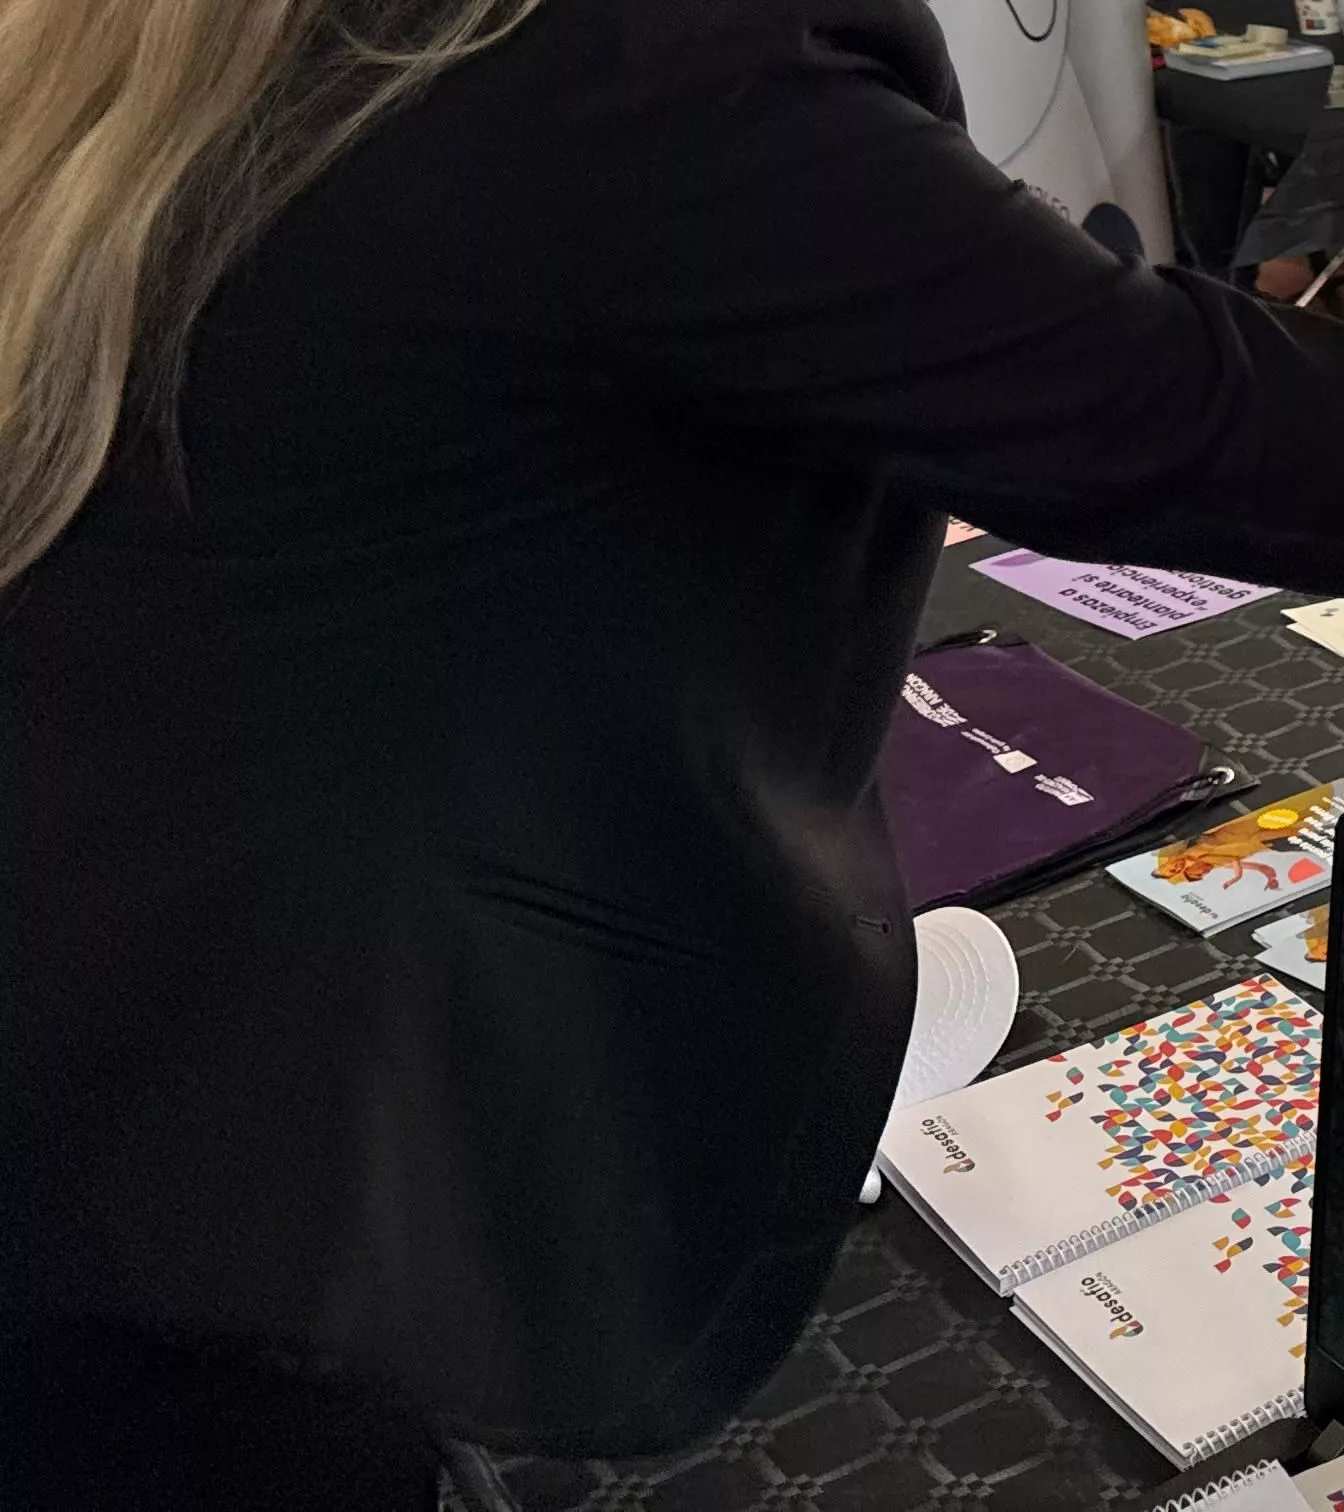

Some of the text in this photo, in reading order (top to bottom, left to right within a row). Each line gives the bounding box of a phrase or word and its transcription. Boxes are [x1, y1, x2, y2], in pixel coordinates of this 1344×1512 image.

[1095, 581, 1192, 619] plantearte
[1177, 565, 1249, 599] gestion
[1058, 587, 1156, 630] Empiezas a
[921, 1117, 968, 1162] desafío
[1081, 1276, 1133, 1324] desafío
